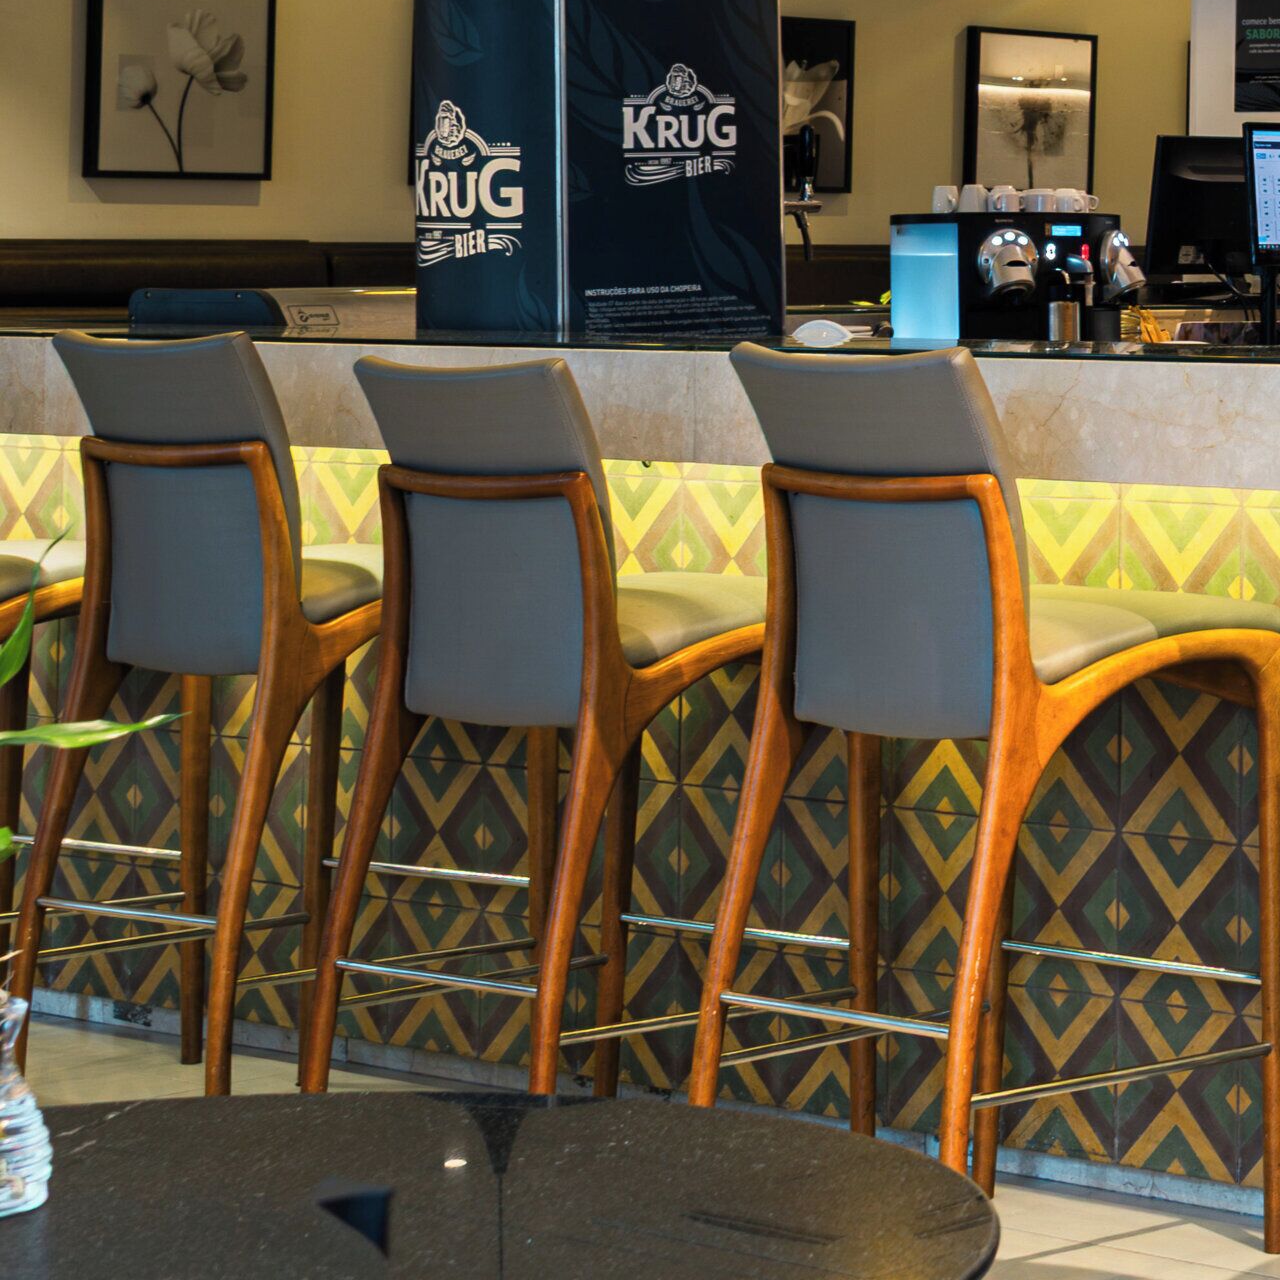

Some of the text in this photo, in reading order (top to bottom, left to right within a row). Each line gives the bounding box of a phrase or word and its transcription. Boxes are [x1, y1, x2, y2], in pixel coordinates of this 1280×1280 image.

[622, 104, 737, 150] KRUG
[685, 156, 712, 178] BIER
[415, 157, 524, 219] KRUG
[455, 229, 486, 258] BIER
[585, 284, 702, 297] INSTRUÇÕES PARA USO DA CHOPEIRA
